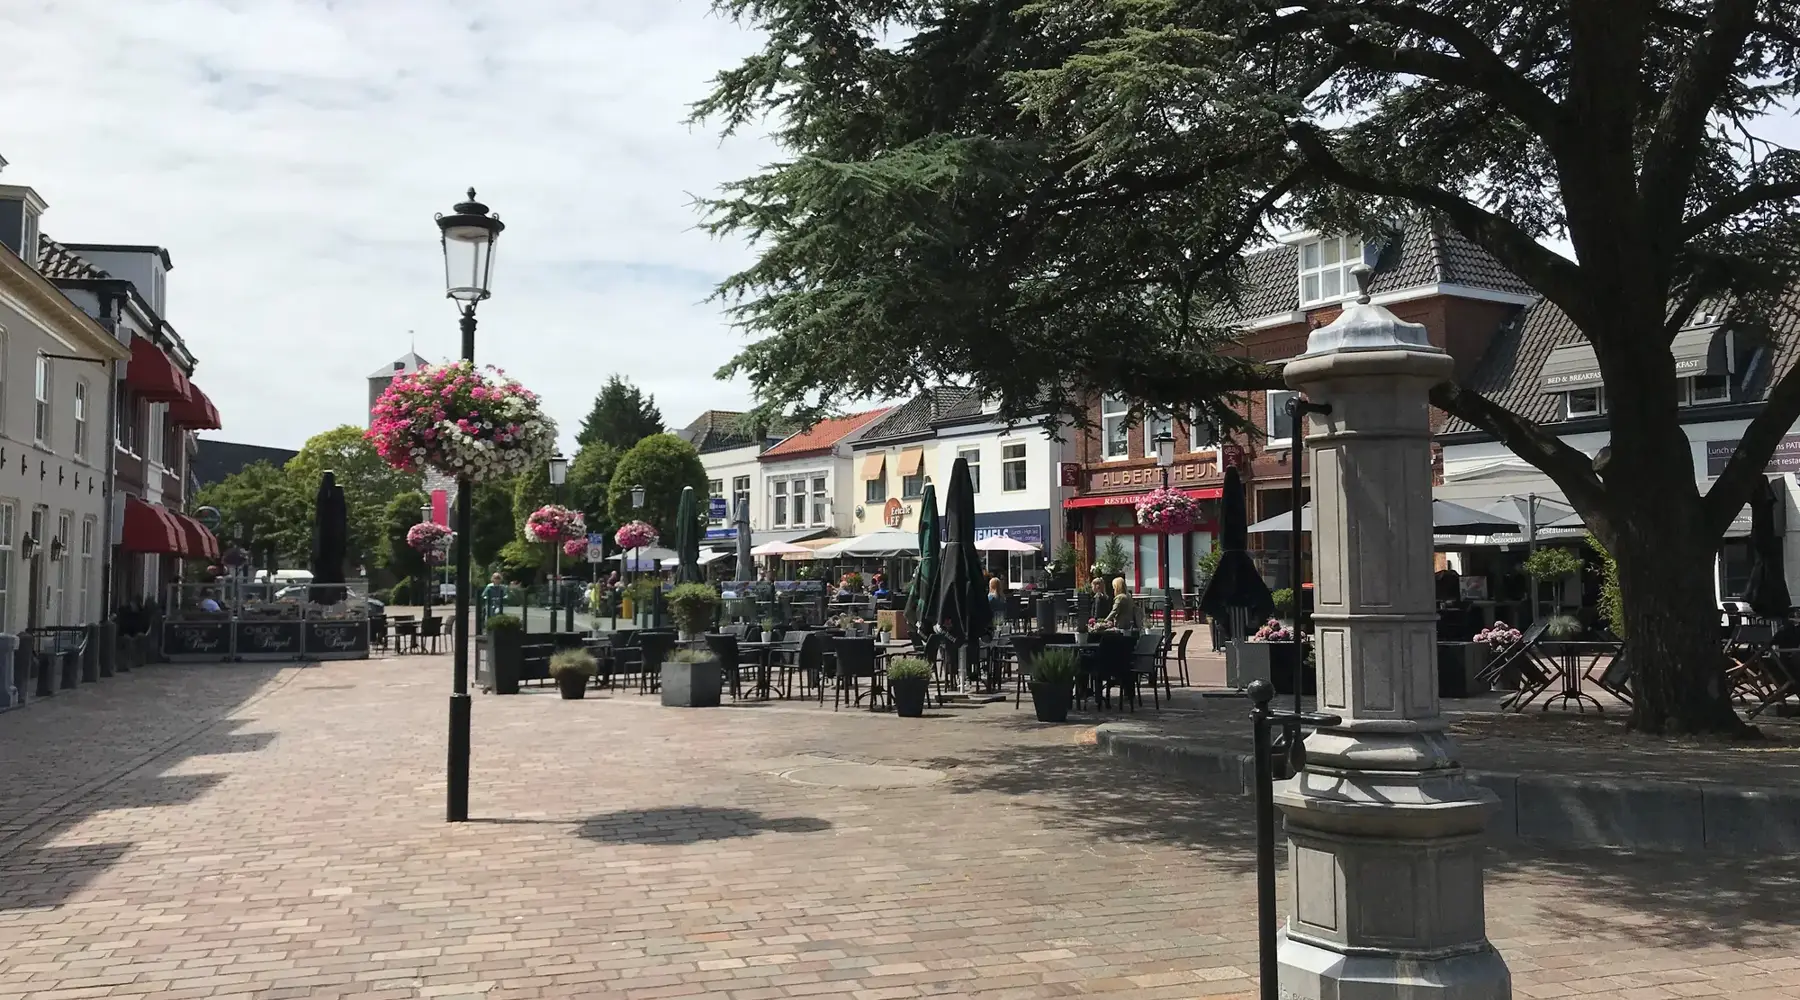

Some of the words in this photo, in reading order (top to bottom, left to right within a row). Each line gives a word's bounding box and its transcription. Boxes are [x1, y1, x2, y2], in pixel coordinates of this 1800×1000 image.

[1570, 371, 1602, 381] BREAKFAS
[1708, 446, 1729, 455] Lunch
[1103, 467, 1163, 487] ALBERT
[885, 516, 900, 526] LEF
